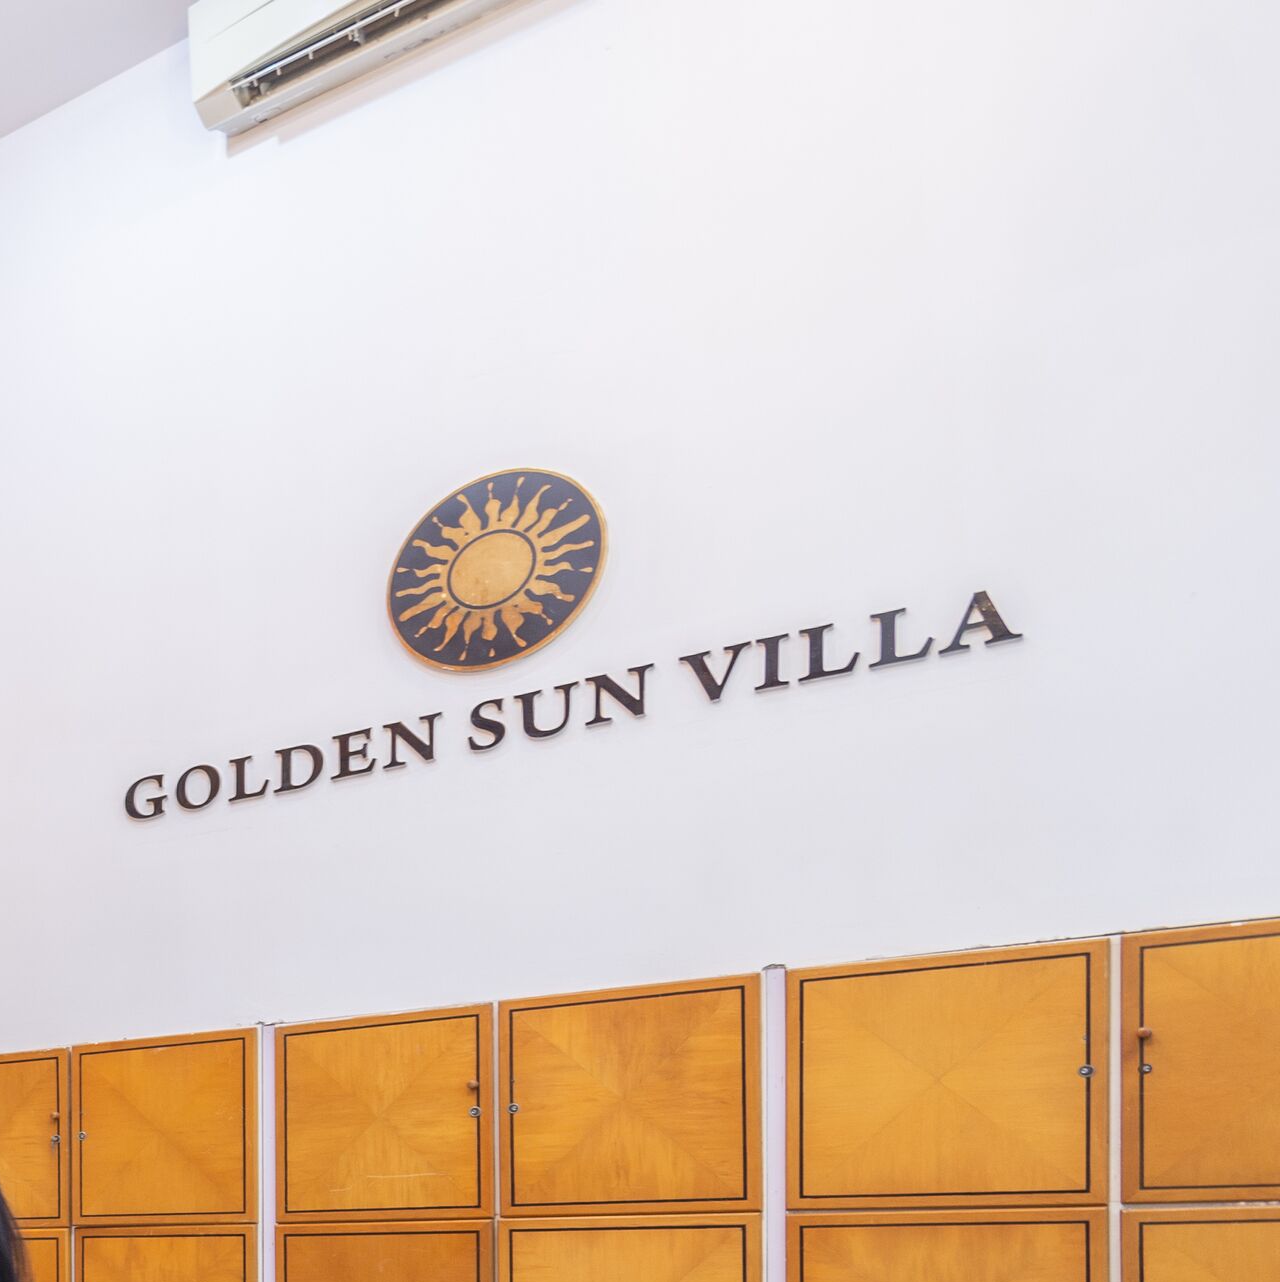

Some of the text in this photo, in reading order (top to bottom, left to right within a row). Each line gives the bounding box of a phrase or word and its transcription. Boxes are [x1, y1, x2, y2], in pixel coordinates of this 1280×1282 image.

[124, 590, 1024, 822] GOLDEN SUN VILLA
